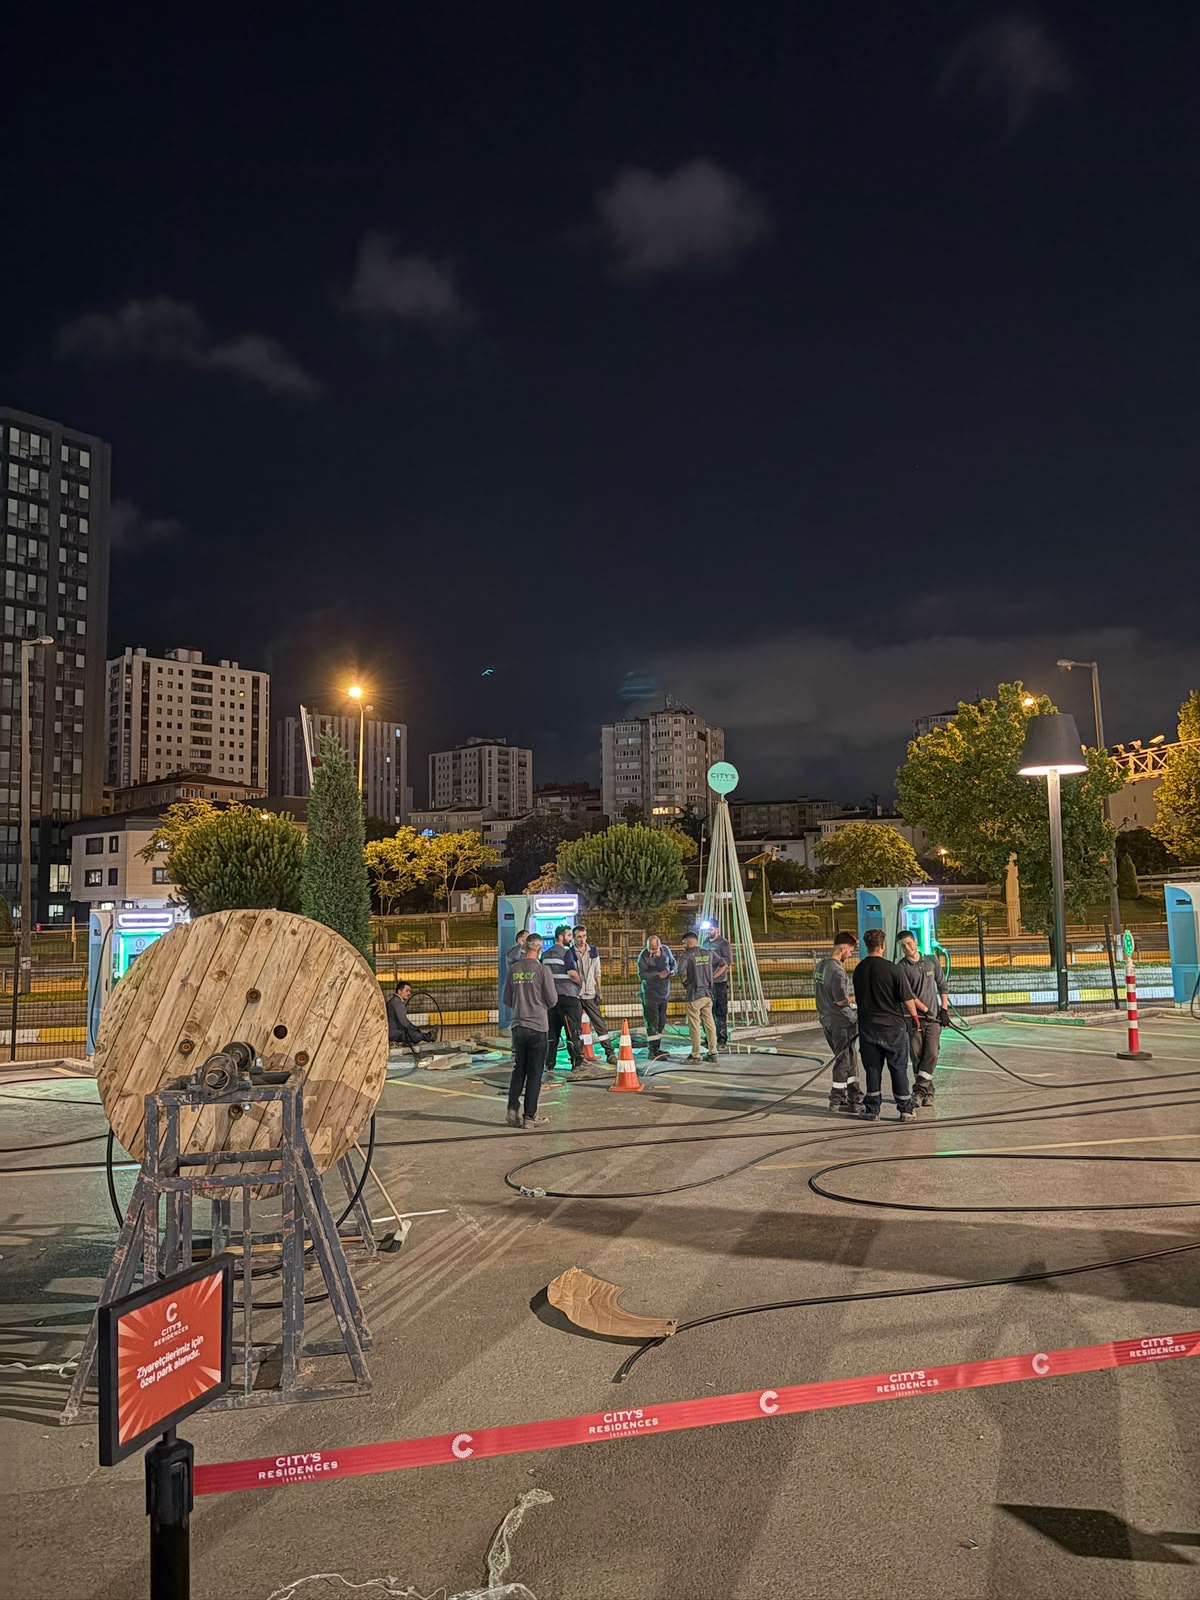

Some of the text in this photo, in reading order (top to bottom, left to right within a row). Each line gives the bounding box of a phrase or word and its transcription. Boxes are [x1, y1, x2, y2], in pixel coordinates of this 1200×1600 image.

[166, 1302, 178, 1322] C
[1140, 1336, 1174, 1348] CITY'S
[136, 1335, 204, 1380] Ziyaretçilerimiz için
[1129, 1344, 1187, 1358] RESIDENCES
[140, 1371, 156, 1389] özel
[156, 1362, 174, 1382] park
[889, 1370, 926, 1383] CITY'S
[876, 1378, 939, 1394] RESIDENCES
[603, 1408, 644, 1423] CITY'S
[588, 1417, 659, 1435] RESIDENCES
[275, 1452, 322, 1468] CITY'S
[258, 1460, 339, 1480] RESIDENCES
